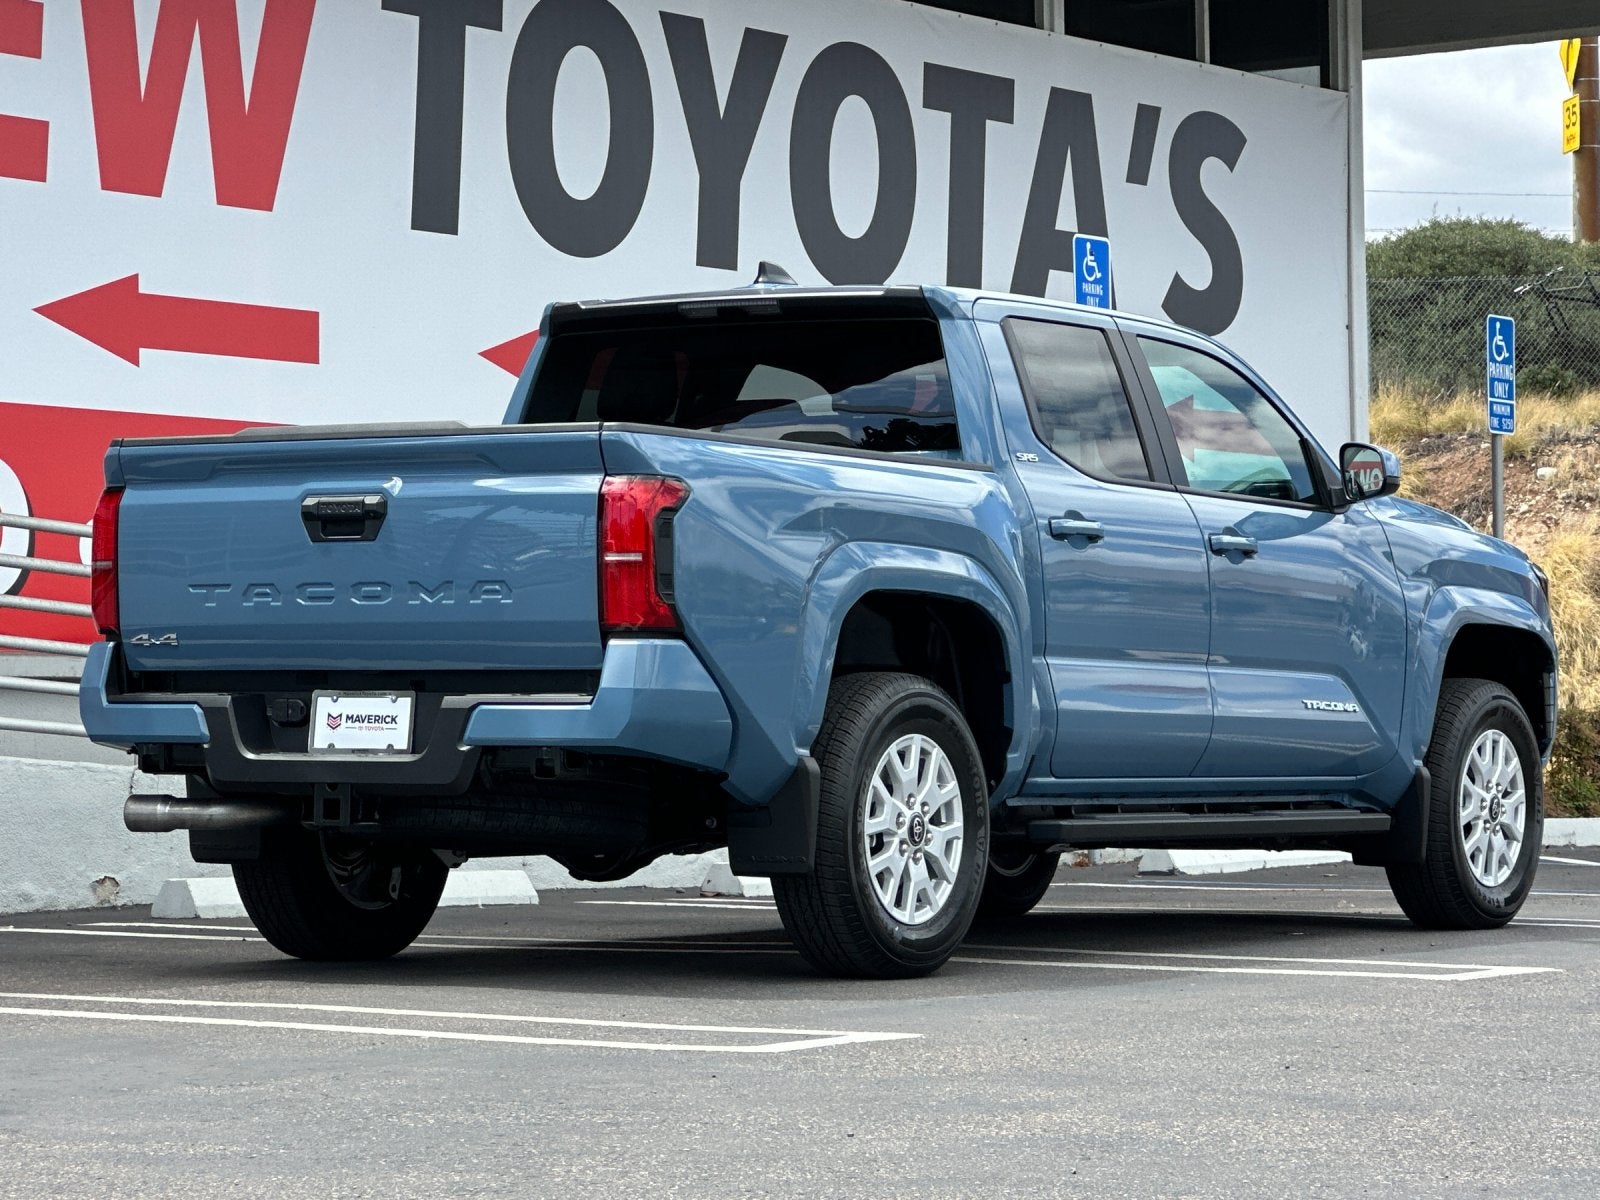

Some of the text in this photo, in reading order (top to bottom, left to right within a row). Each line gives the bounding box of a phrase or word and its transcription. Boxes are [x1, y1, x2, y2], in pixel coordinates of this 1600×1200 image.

[1565, 104, 1577, 129] 35
[381, 0, 1248, 338] TOYOTA'S
[1082, 282, 1103, 296] PARKING
[1087, 296, 1099, 307] ONLY
[1489, 361, 1513, 380] PARKING
[1494, 381, 1509, 398] ONLY
[320, 503, 361, 513] TOYOTA
[187, 579, 514, 607] TACOMA
[1302, 699, 1360, 713] TACOMA
[345, 713, 399, 725] MAVERICK
